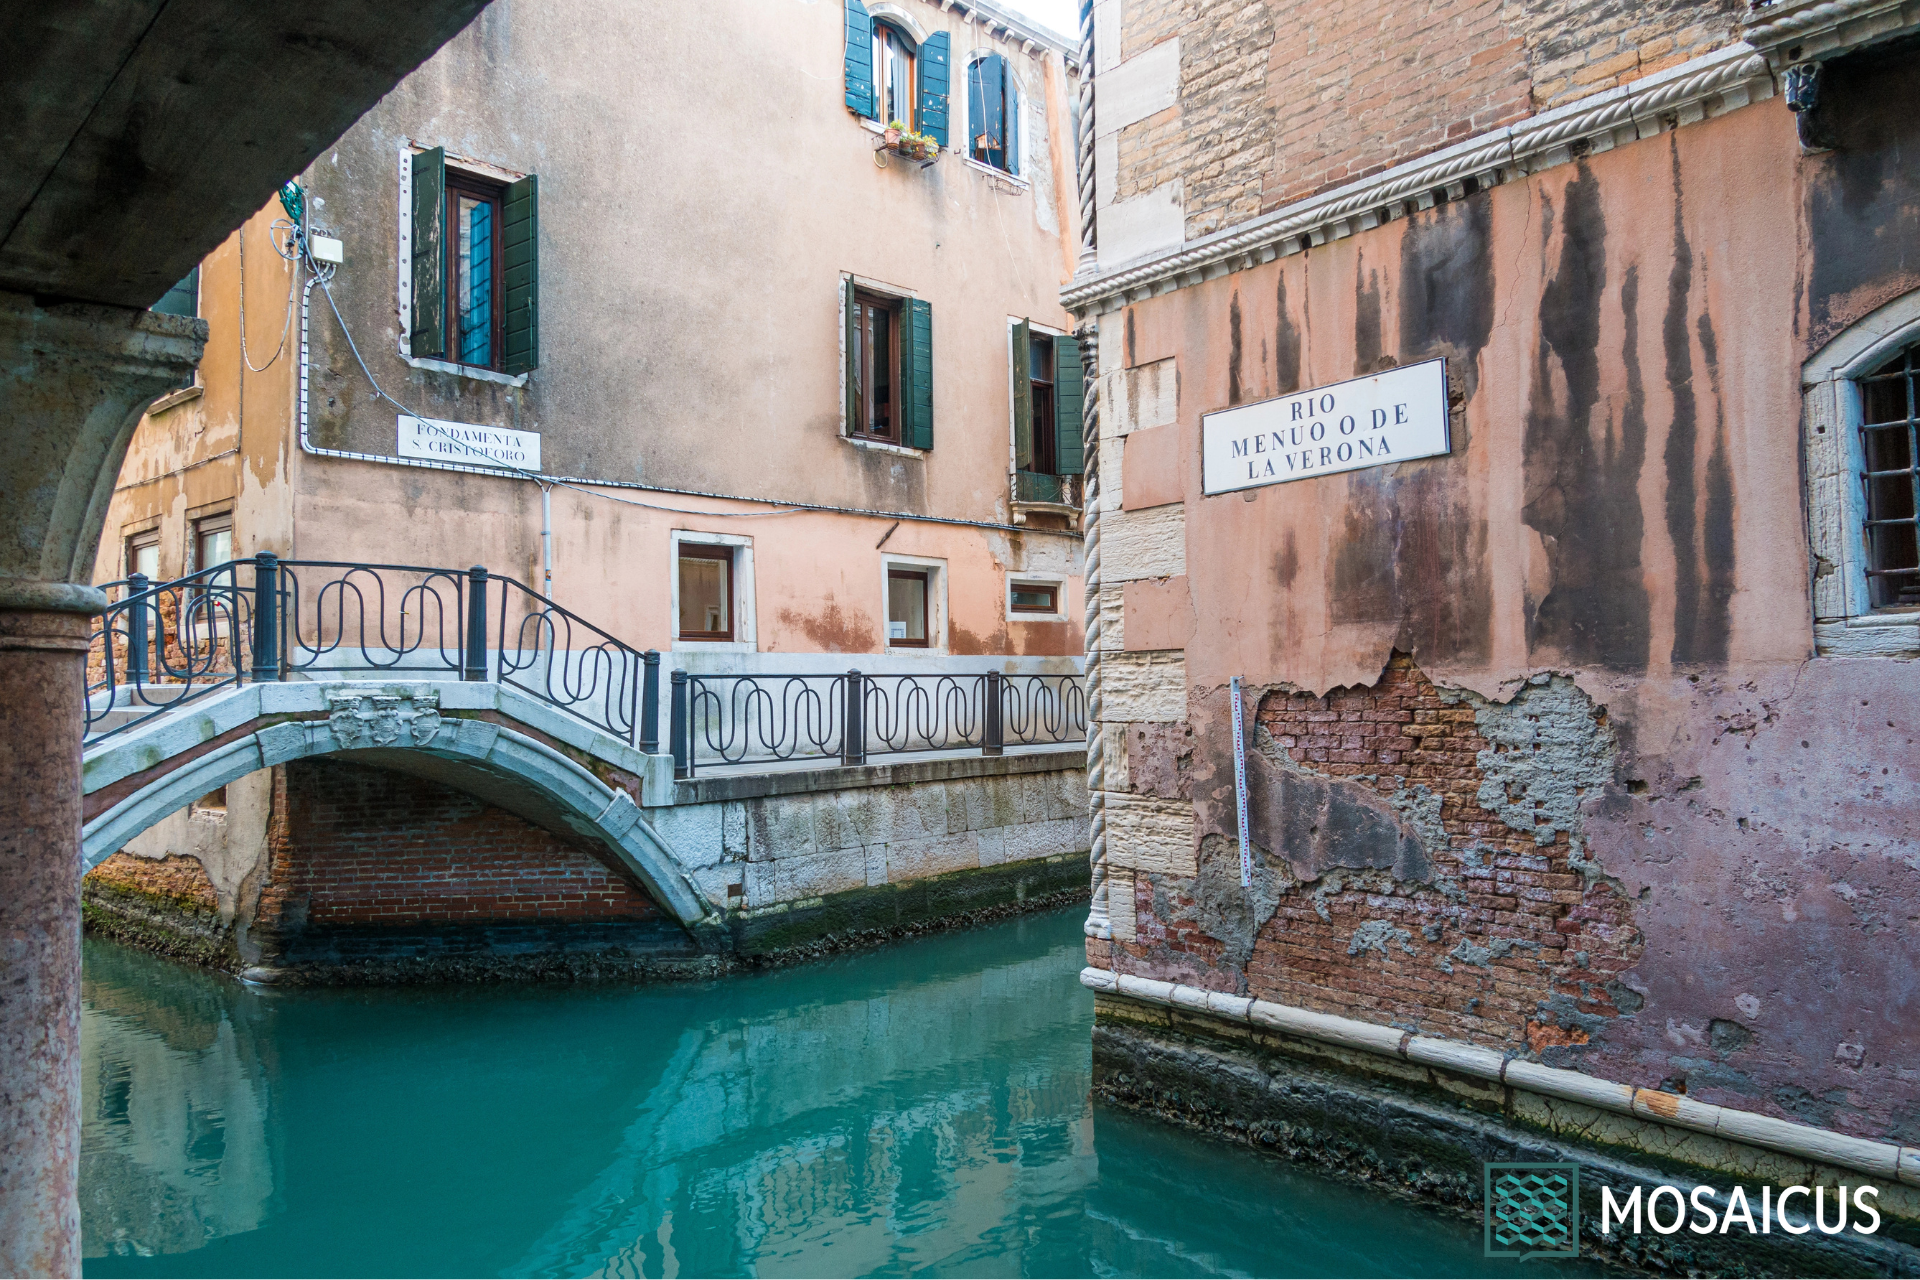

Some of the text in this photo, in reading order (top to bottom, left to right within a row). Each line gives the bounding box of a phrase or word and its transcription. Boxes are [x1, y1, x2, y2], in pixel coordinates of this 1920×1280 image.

[1290, 394, 1335, 422] RIO
[417, 424, 521, 447] FONDAMENTA
[1231, 403, 1408, 458] MENUO O DE
[429, 441, 525, 461] CRISTOFORO
[1247, 435, 1392, 480] LA VERONA
